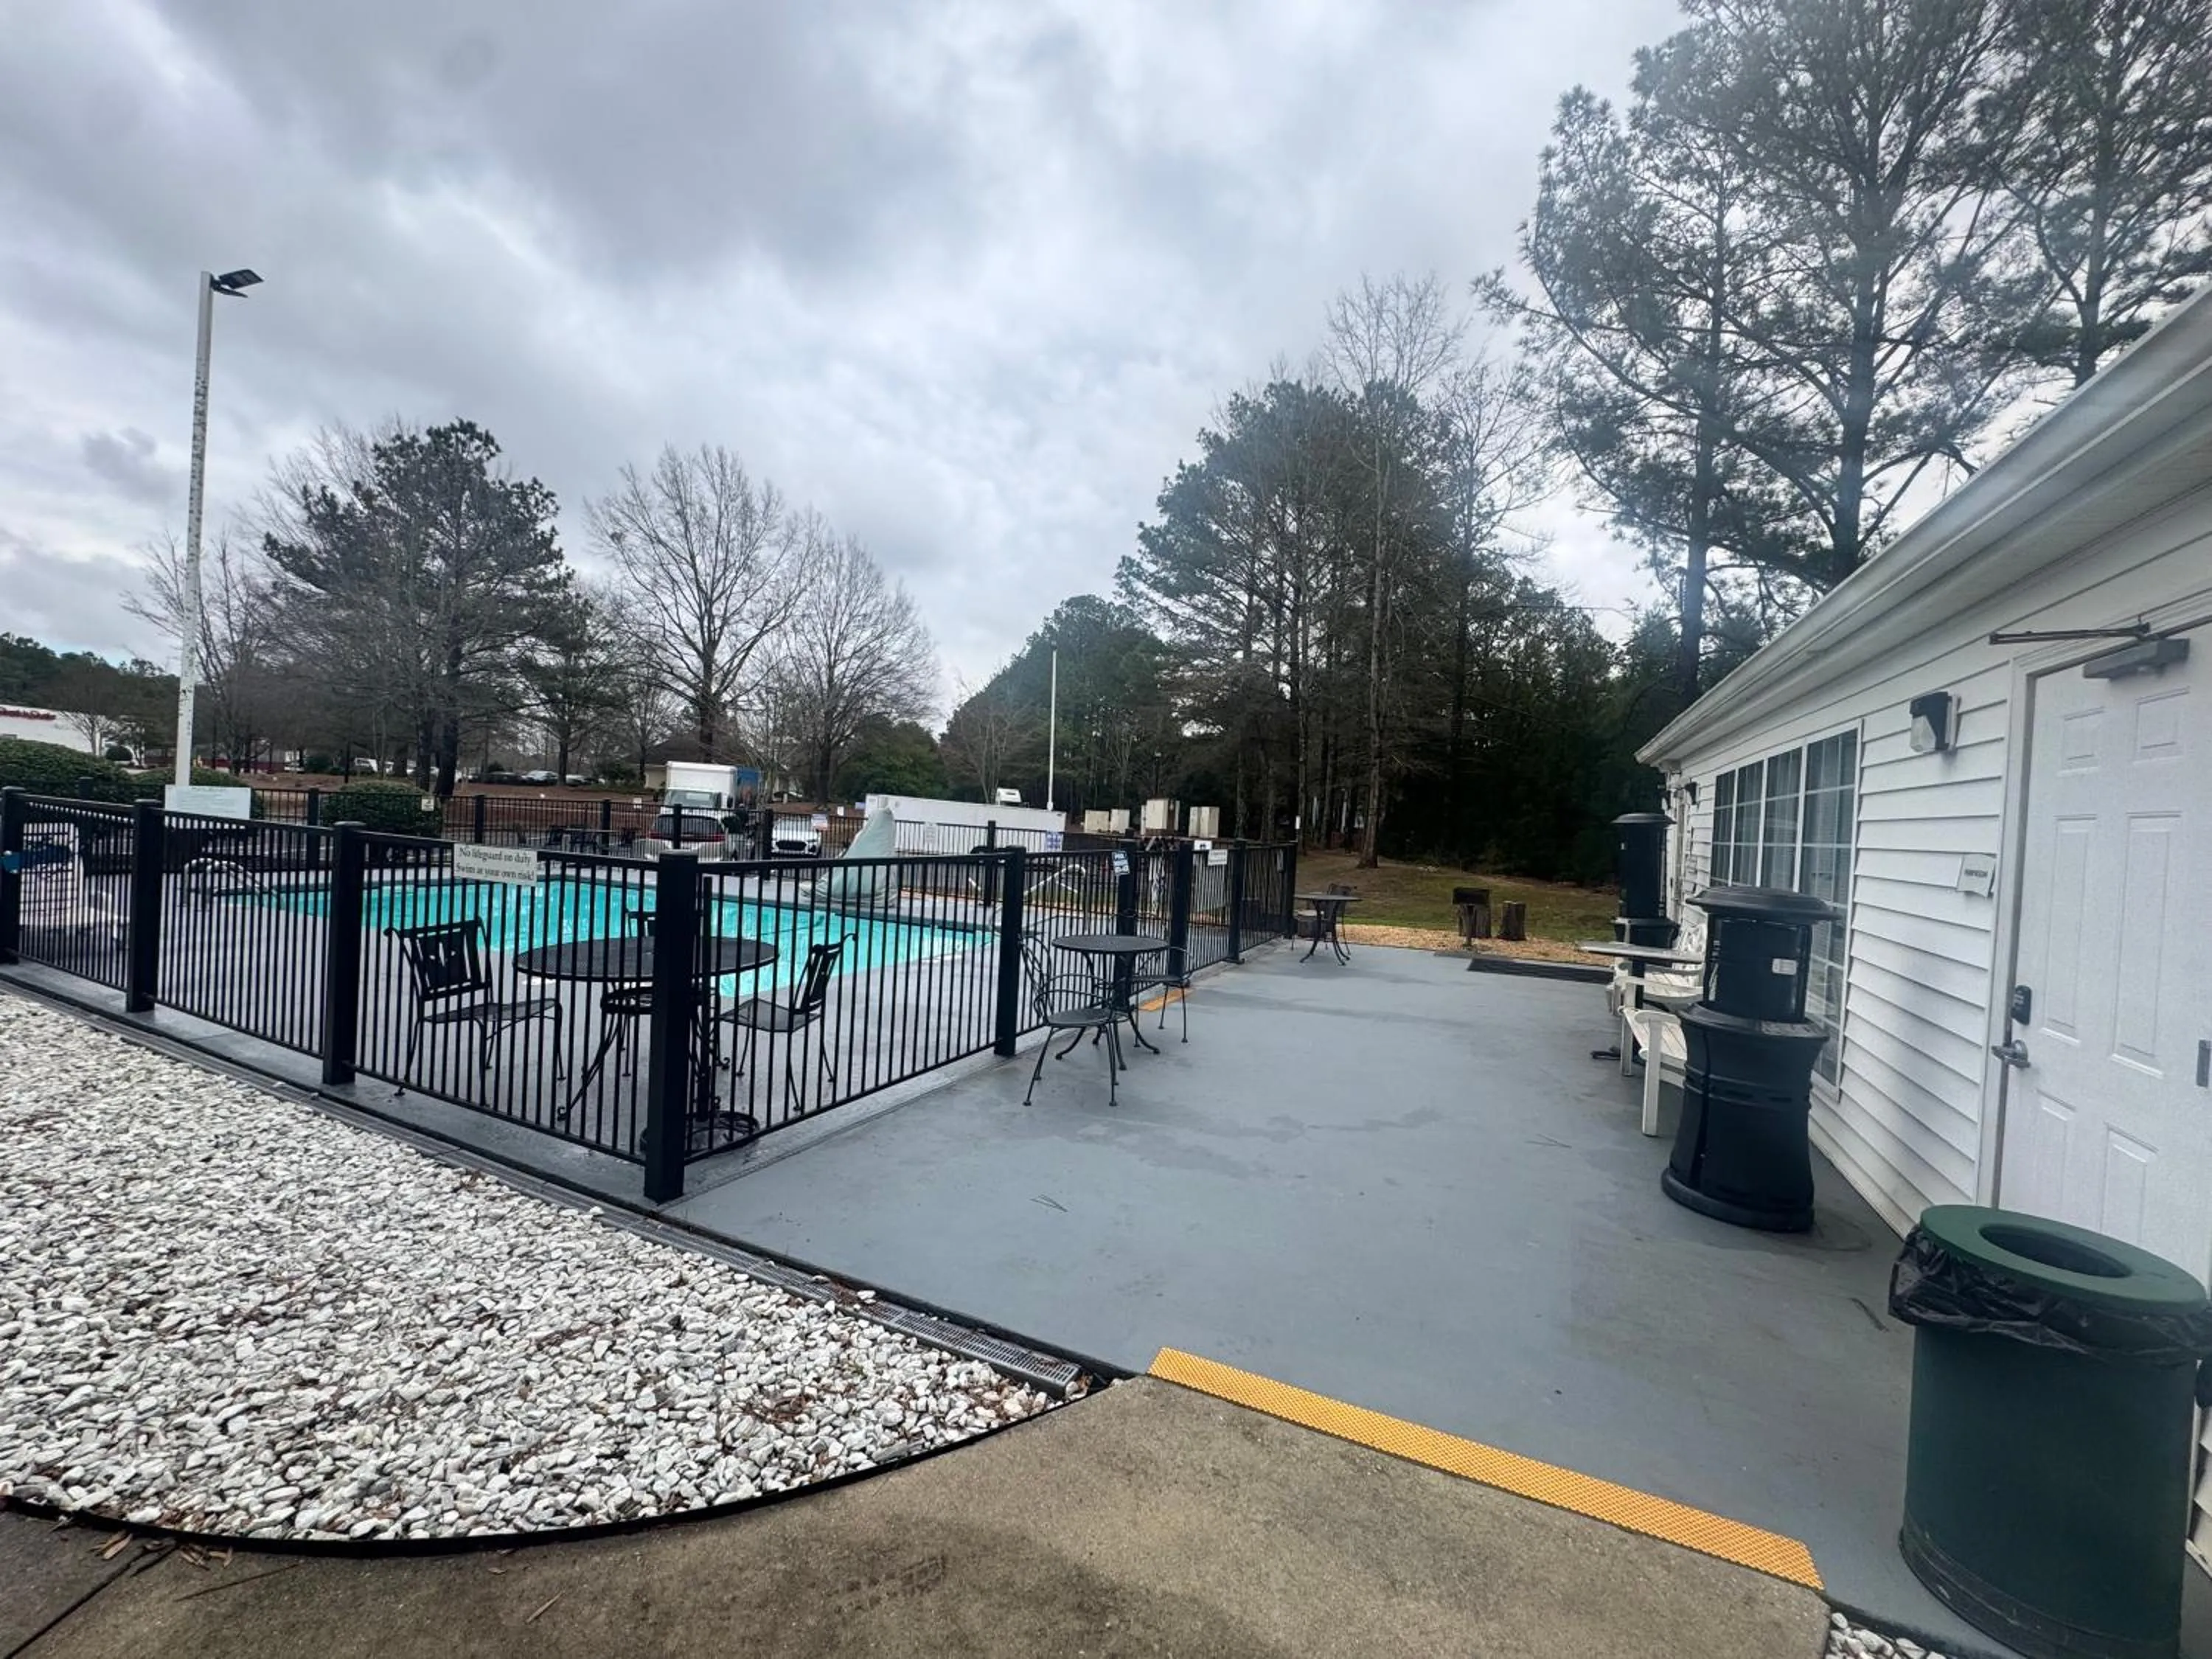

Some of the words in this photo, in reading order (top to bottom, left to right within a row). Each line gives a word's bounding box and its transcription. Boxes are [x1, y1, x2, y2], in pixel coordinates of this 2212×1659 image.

[460, 848, 470, 857] No
[472, 850, 502, 862] lifeguard
[515, 852, 532, 866] duty
[456, 863, 475, 873] Swim
[484, 867, 499, 877] your
